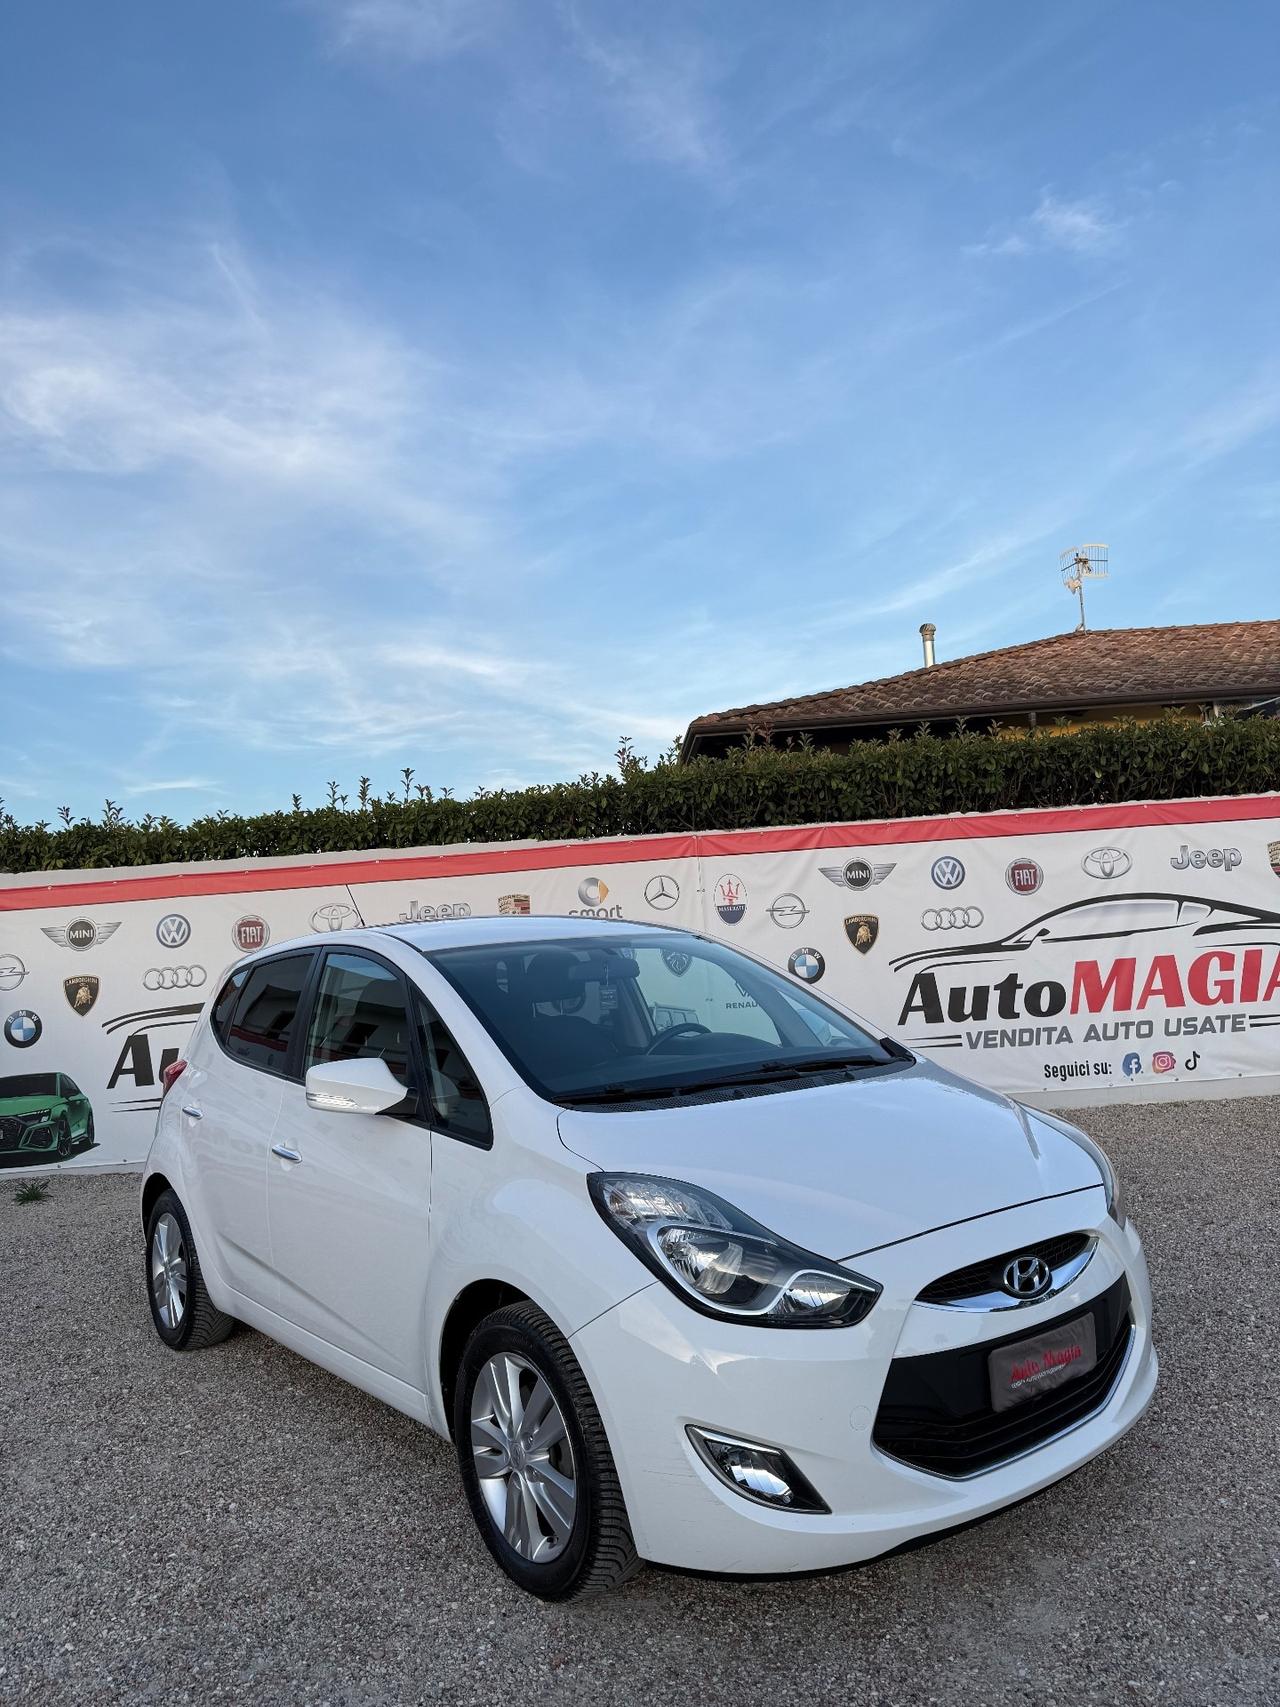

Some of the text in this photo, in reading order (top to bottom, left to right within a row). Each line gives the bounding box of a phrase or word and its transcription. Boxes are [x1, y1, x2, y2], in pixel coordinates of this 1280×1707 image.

[1170, 845, 1242, 871] Jeep
[846, 869, 870, 880] MINI
[1014, 869, 1036, 887] FIAT
[69, 929, 94, 939] MINI
[241, 926, 262, 944] FIAT
[790, 947, 821, 961] BMW
[8, 1010, 39, 1023] BMW
[967, 1013, 1246, 1050] VENDITA AUTO USATE
[1044, 1060, 1113, 1081] Seguici su:
[1009, 1359, 1040, 1384] Auto
[1042, 1344, 1082, 1368] Magia
